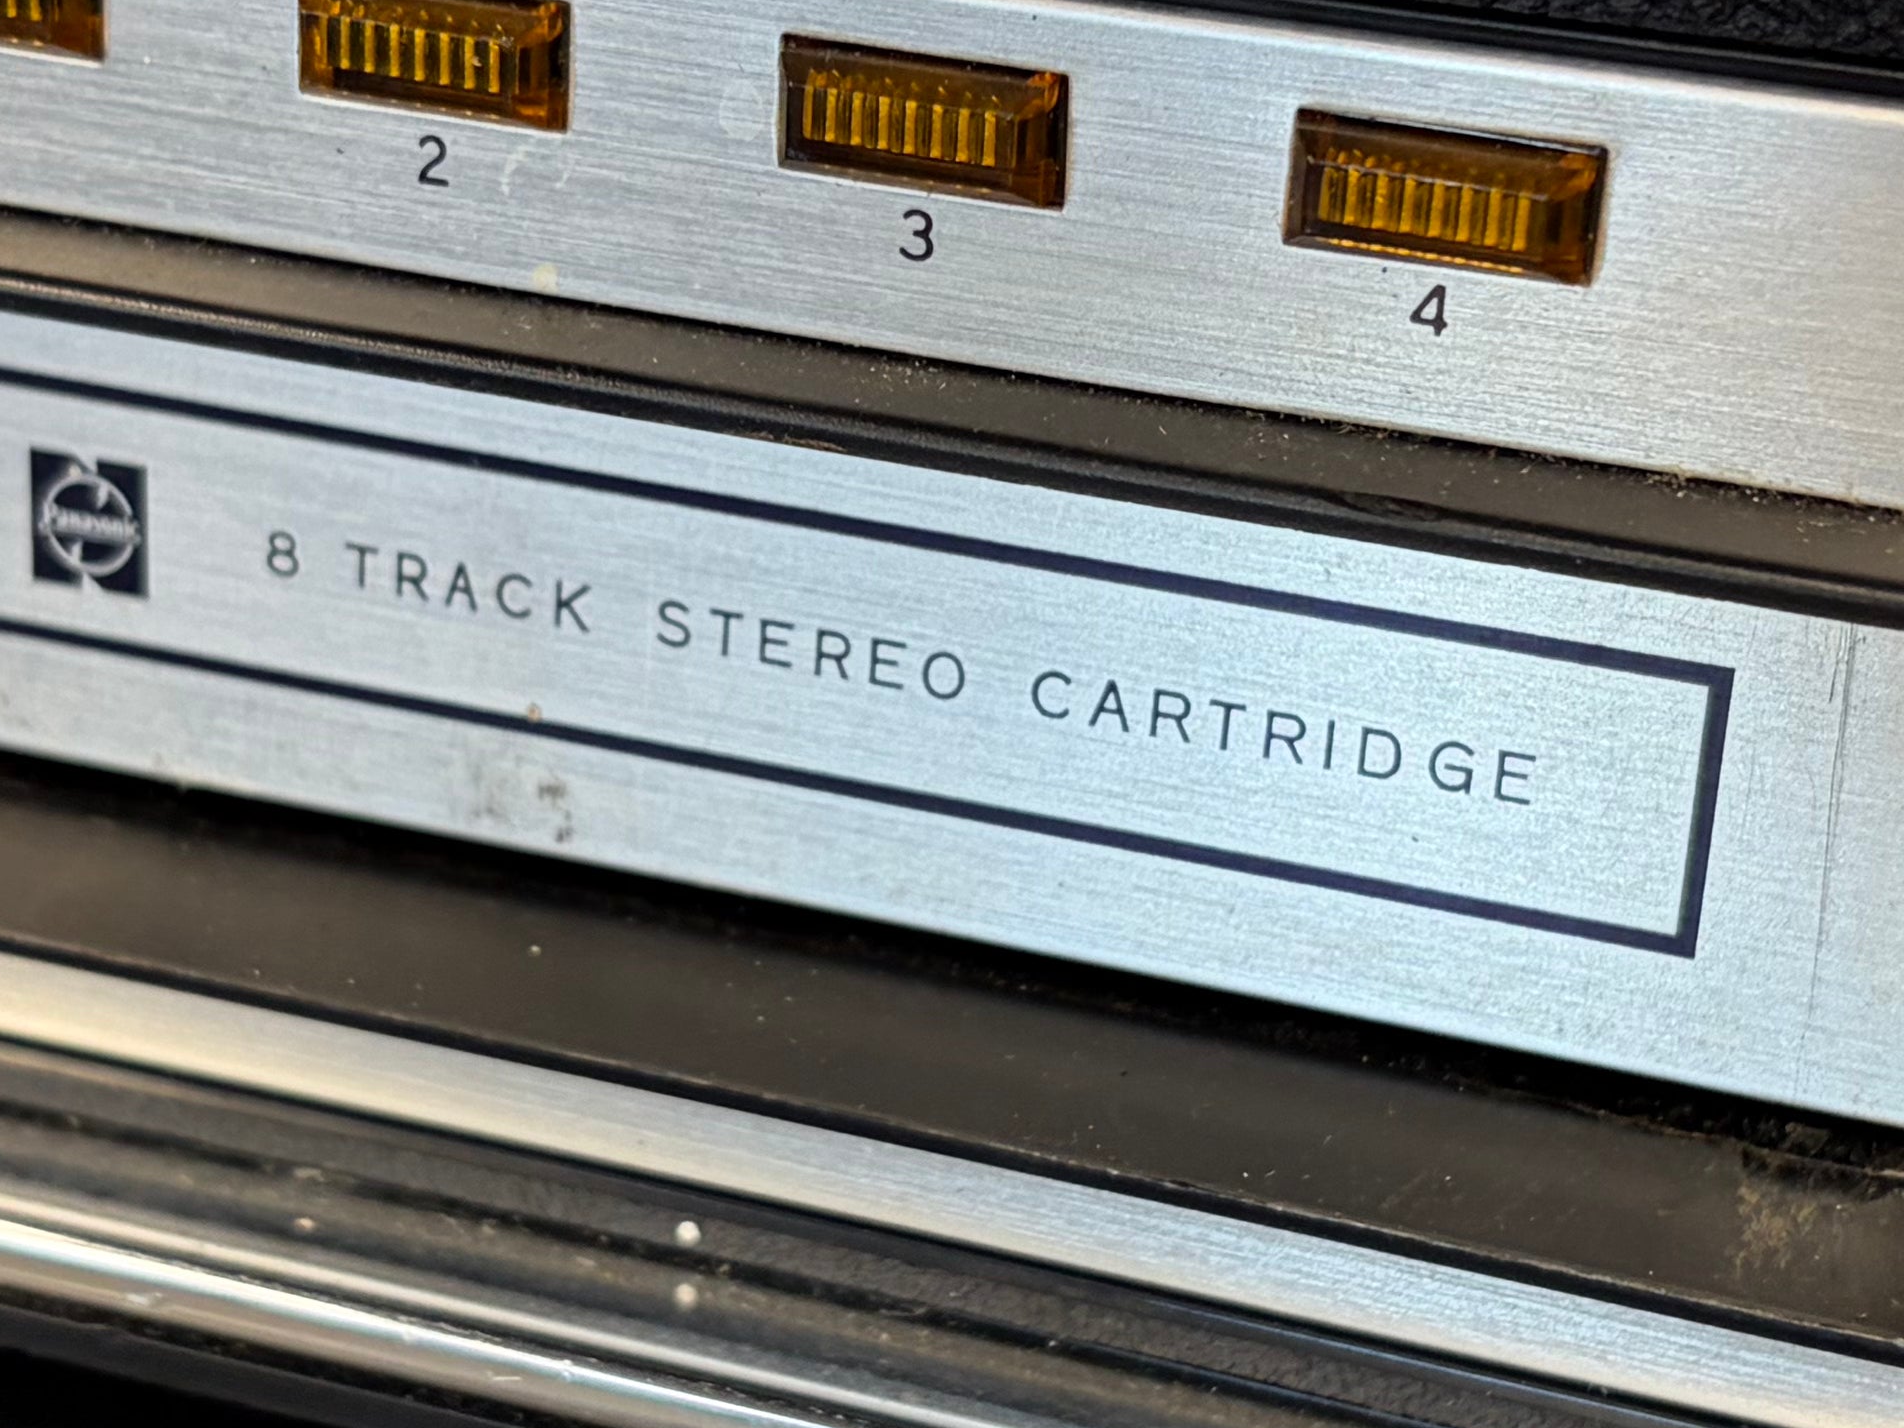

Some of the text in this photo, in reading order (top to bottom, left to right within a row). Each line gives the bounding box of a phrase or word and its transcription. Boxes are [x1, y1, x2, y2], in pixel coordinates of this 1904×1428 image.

[414, 134, 450, 188] 2
[898, 208, 940, 264] 3
[1408, 284, 1450, 338] 4
[264, 530, 1542, 808] 8 TRACK STEREO CARTRIDGE
